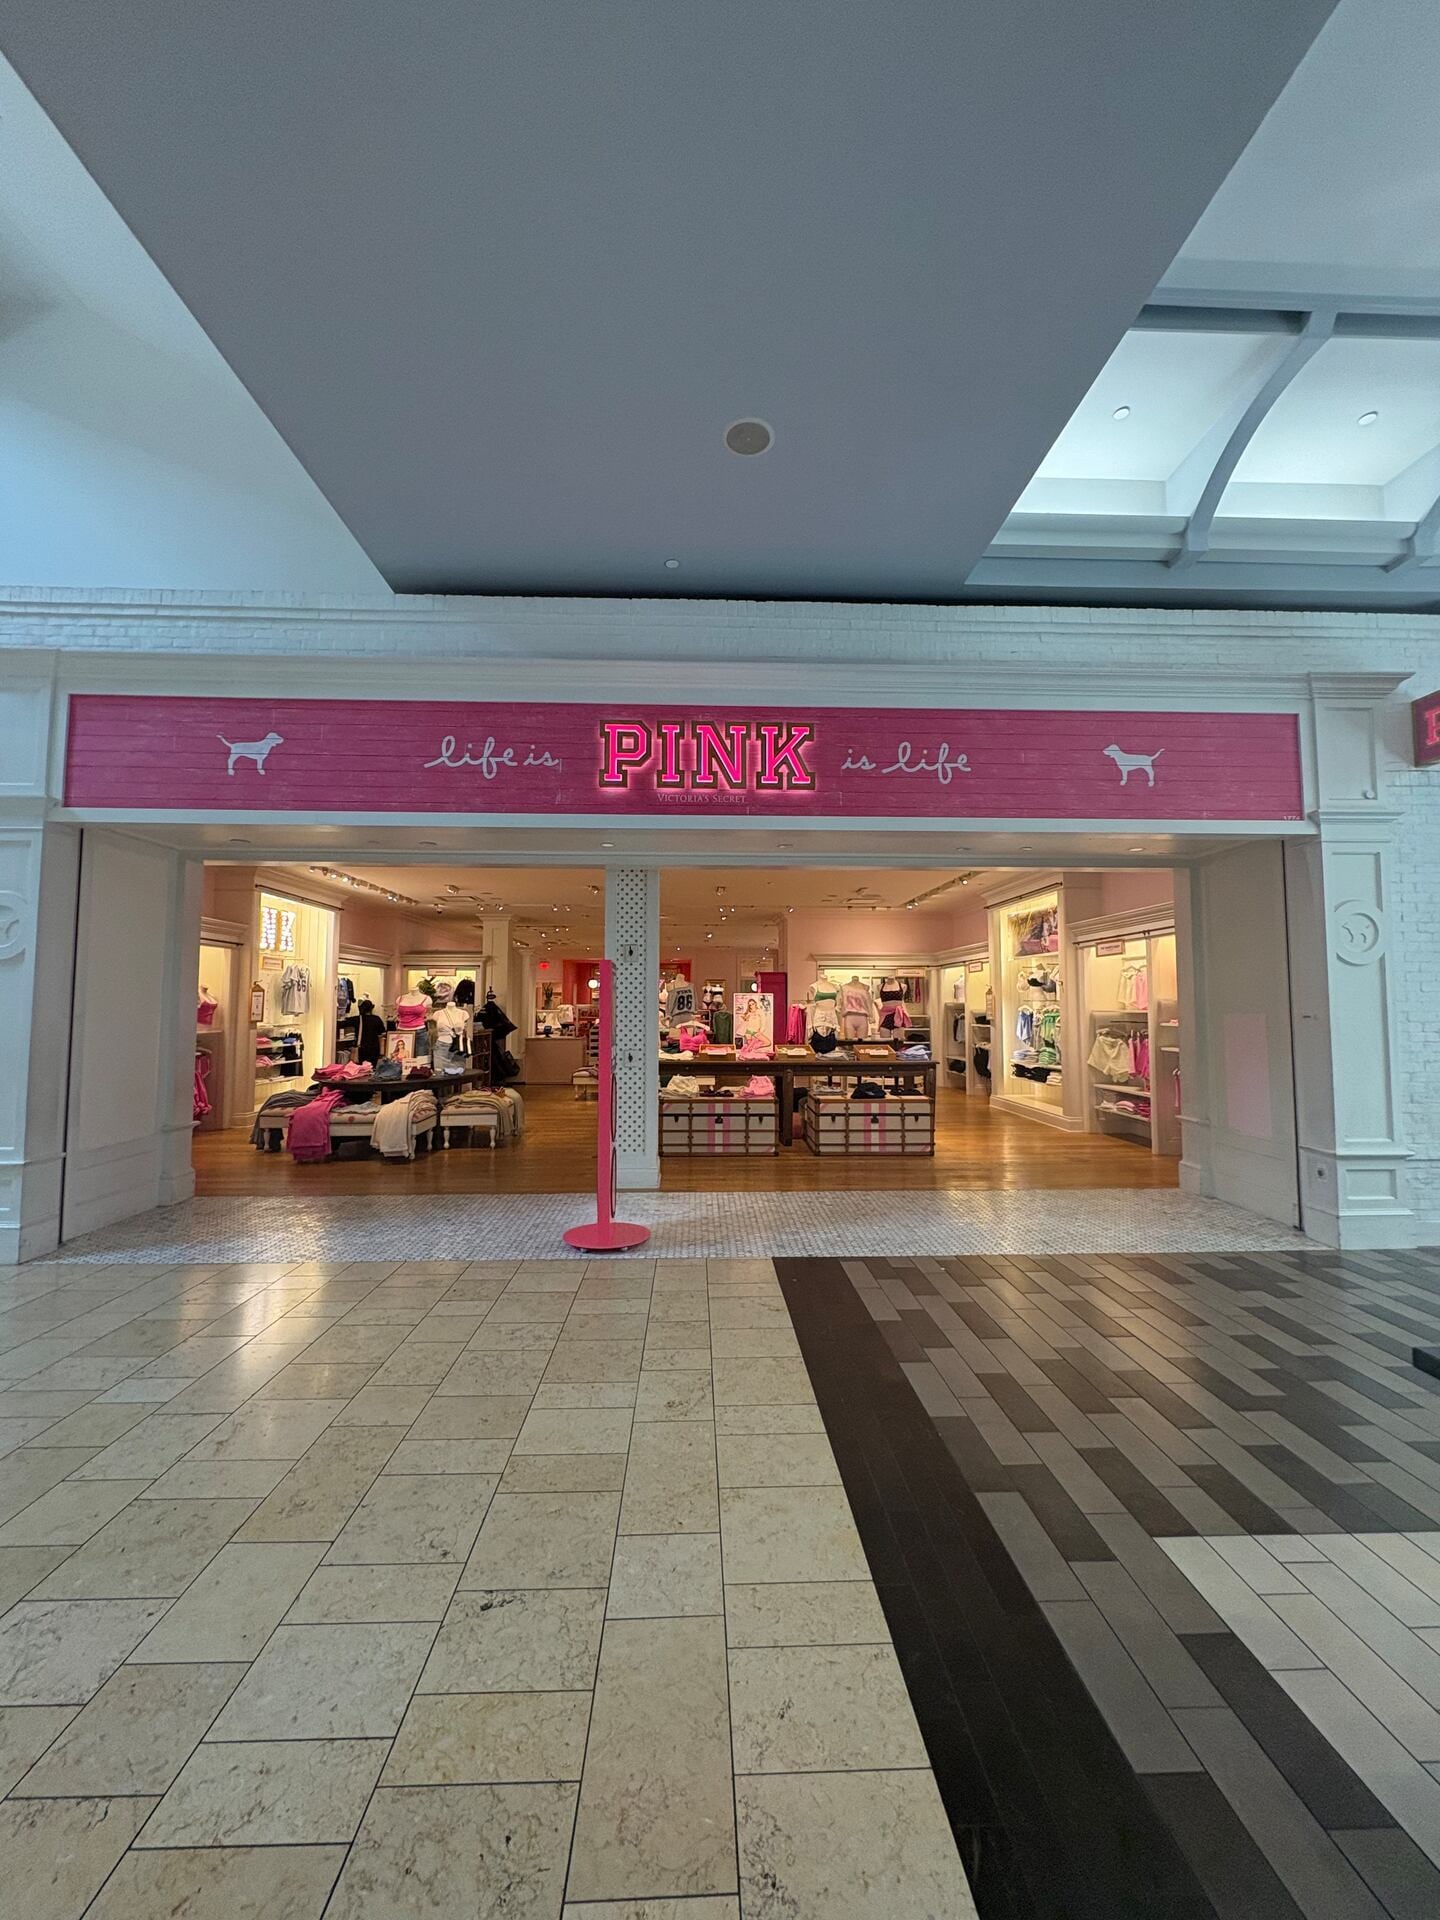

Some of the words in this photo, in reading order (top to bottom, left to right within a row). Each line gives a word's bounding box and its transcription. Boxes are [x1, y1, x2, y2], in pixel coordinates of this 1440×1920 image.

[424, 735, 518, 779] life
[523, 744, 559, 766] is
[599, 719, 816, 790] PINK
[841, 748, 876, 770] is
[881, 741, 972, 785] life
[712, 793, 746, 803] SECRET
[677, 994, 693, 1011] 86
